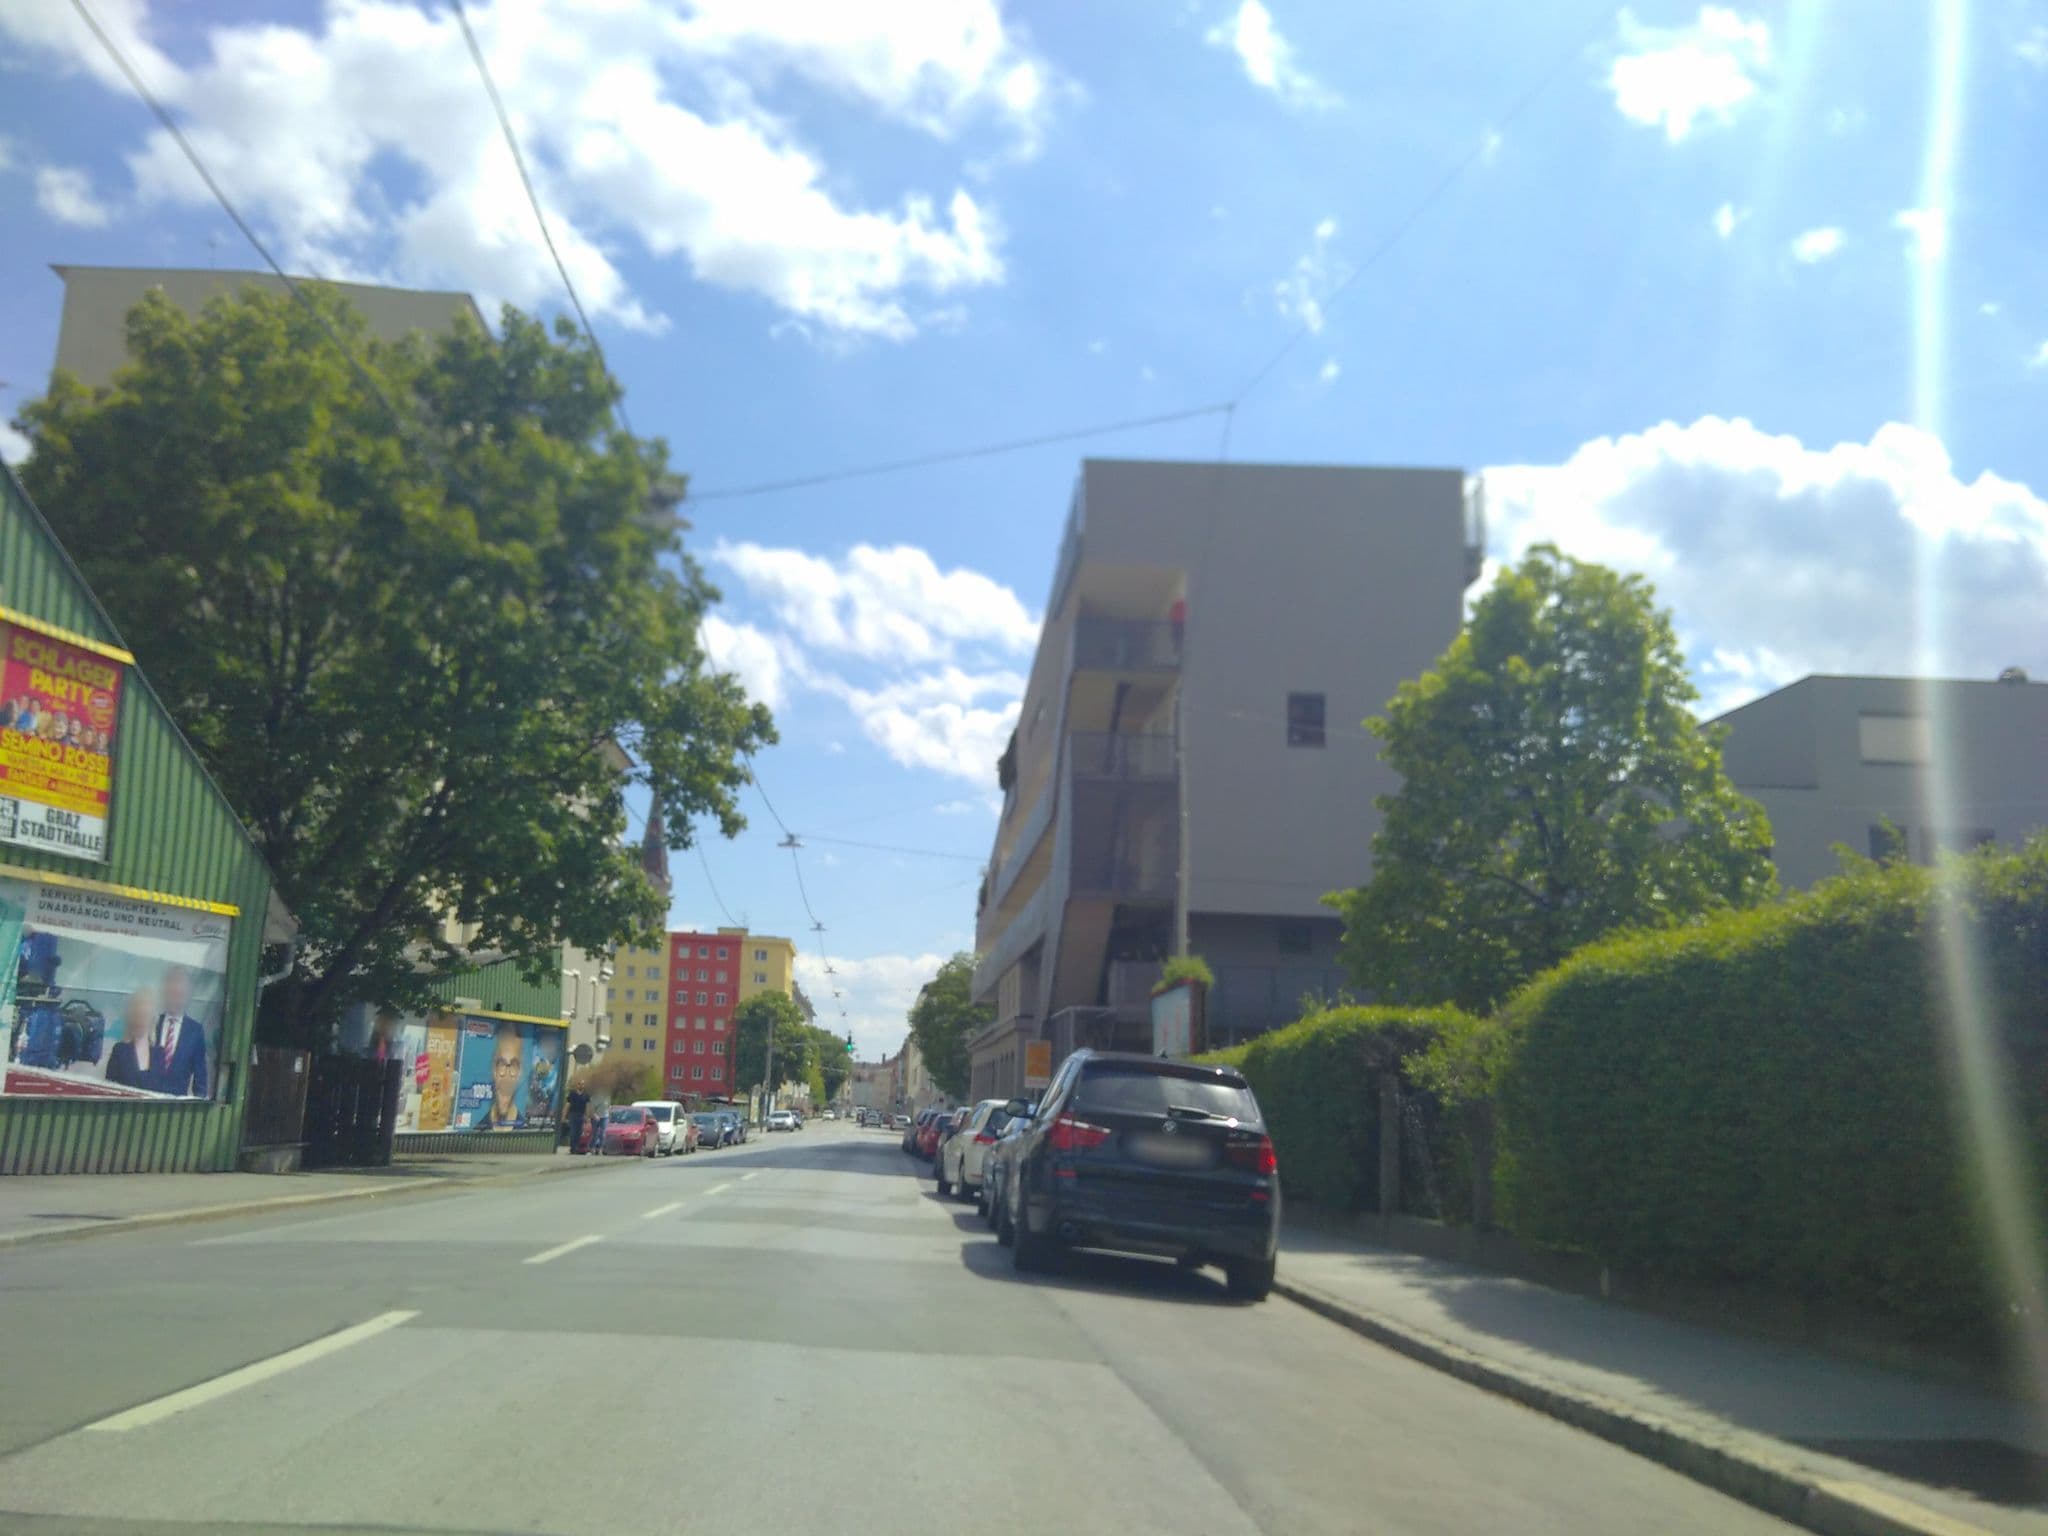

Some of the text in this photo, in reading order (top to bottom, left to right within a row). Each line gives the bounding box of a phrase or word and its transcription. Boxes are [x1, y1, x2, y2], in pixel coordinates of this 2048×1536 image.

[13, 635, 116, 691] SCHLAGER
[31, 667, 92, 706] PARTY
[65, 745, 108, 776] ROSSI
[46, 807, 80, 830] GRAZ
[20, 819, 102, 850] STADTHALLE
[86, 896, 158, 915] NACHRICHTEN
[114, 911, 135, 924] UND
[473, 1084, 492, 1098] 100%
